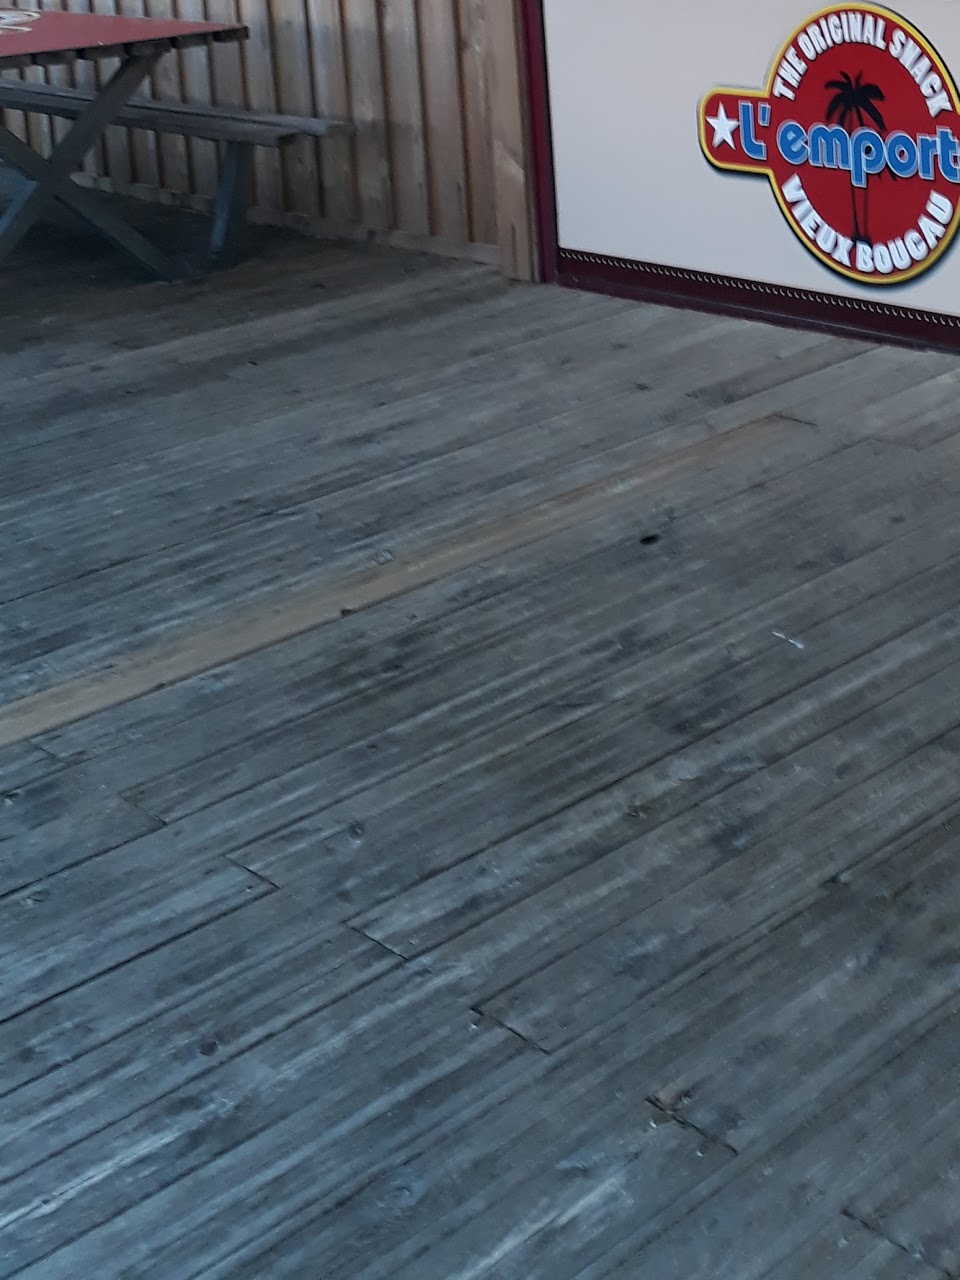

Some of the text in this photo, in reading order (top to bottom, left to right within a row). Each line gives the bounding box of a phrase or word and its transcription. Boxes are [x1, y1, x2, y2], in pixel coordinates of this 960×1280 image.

[773, 11, 953, 118] THE ORIGINAL SNACK
[781, 173, 853, 267] VIEUX
